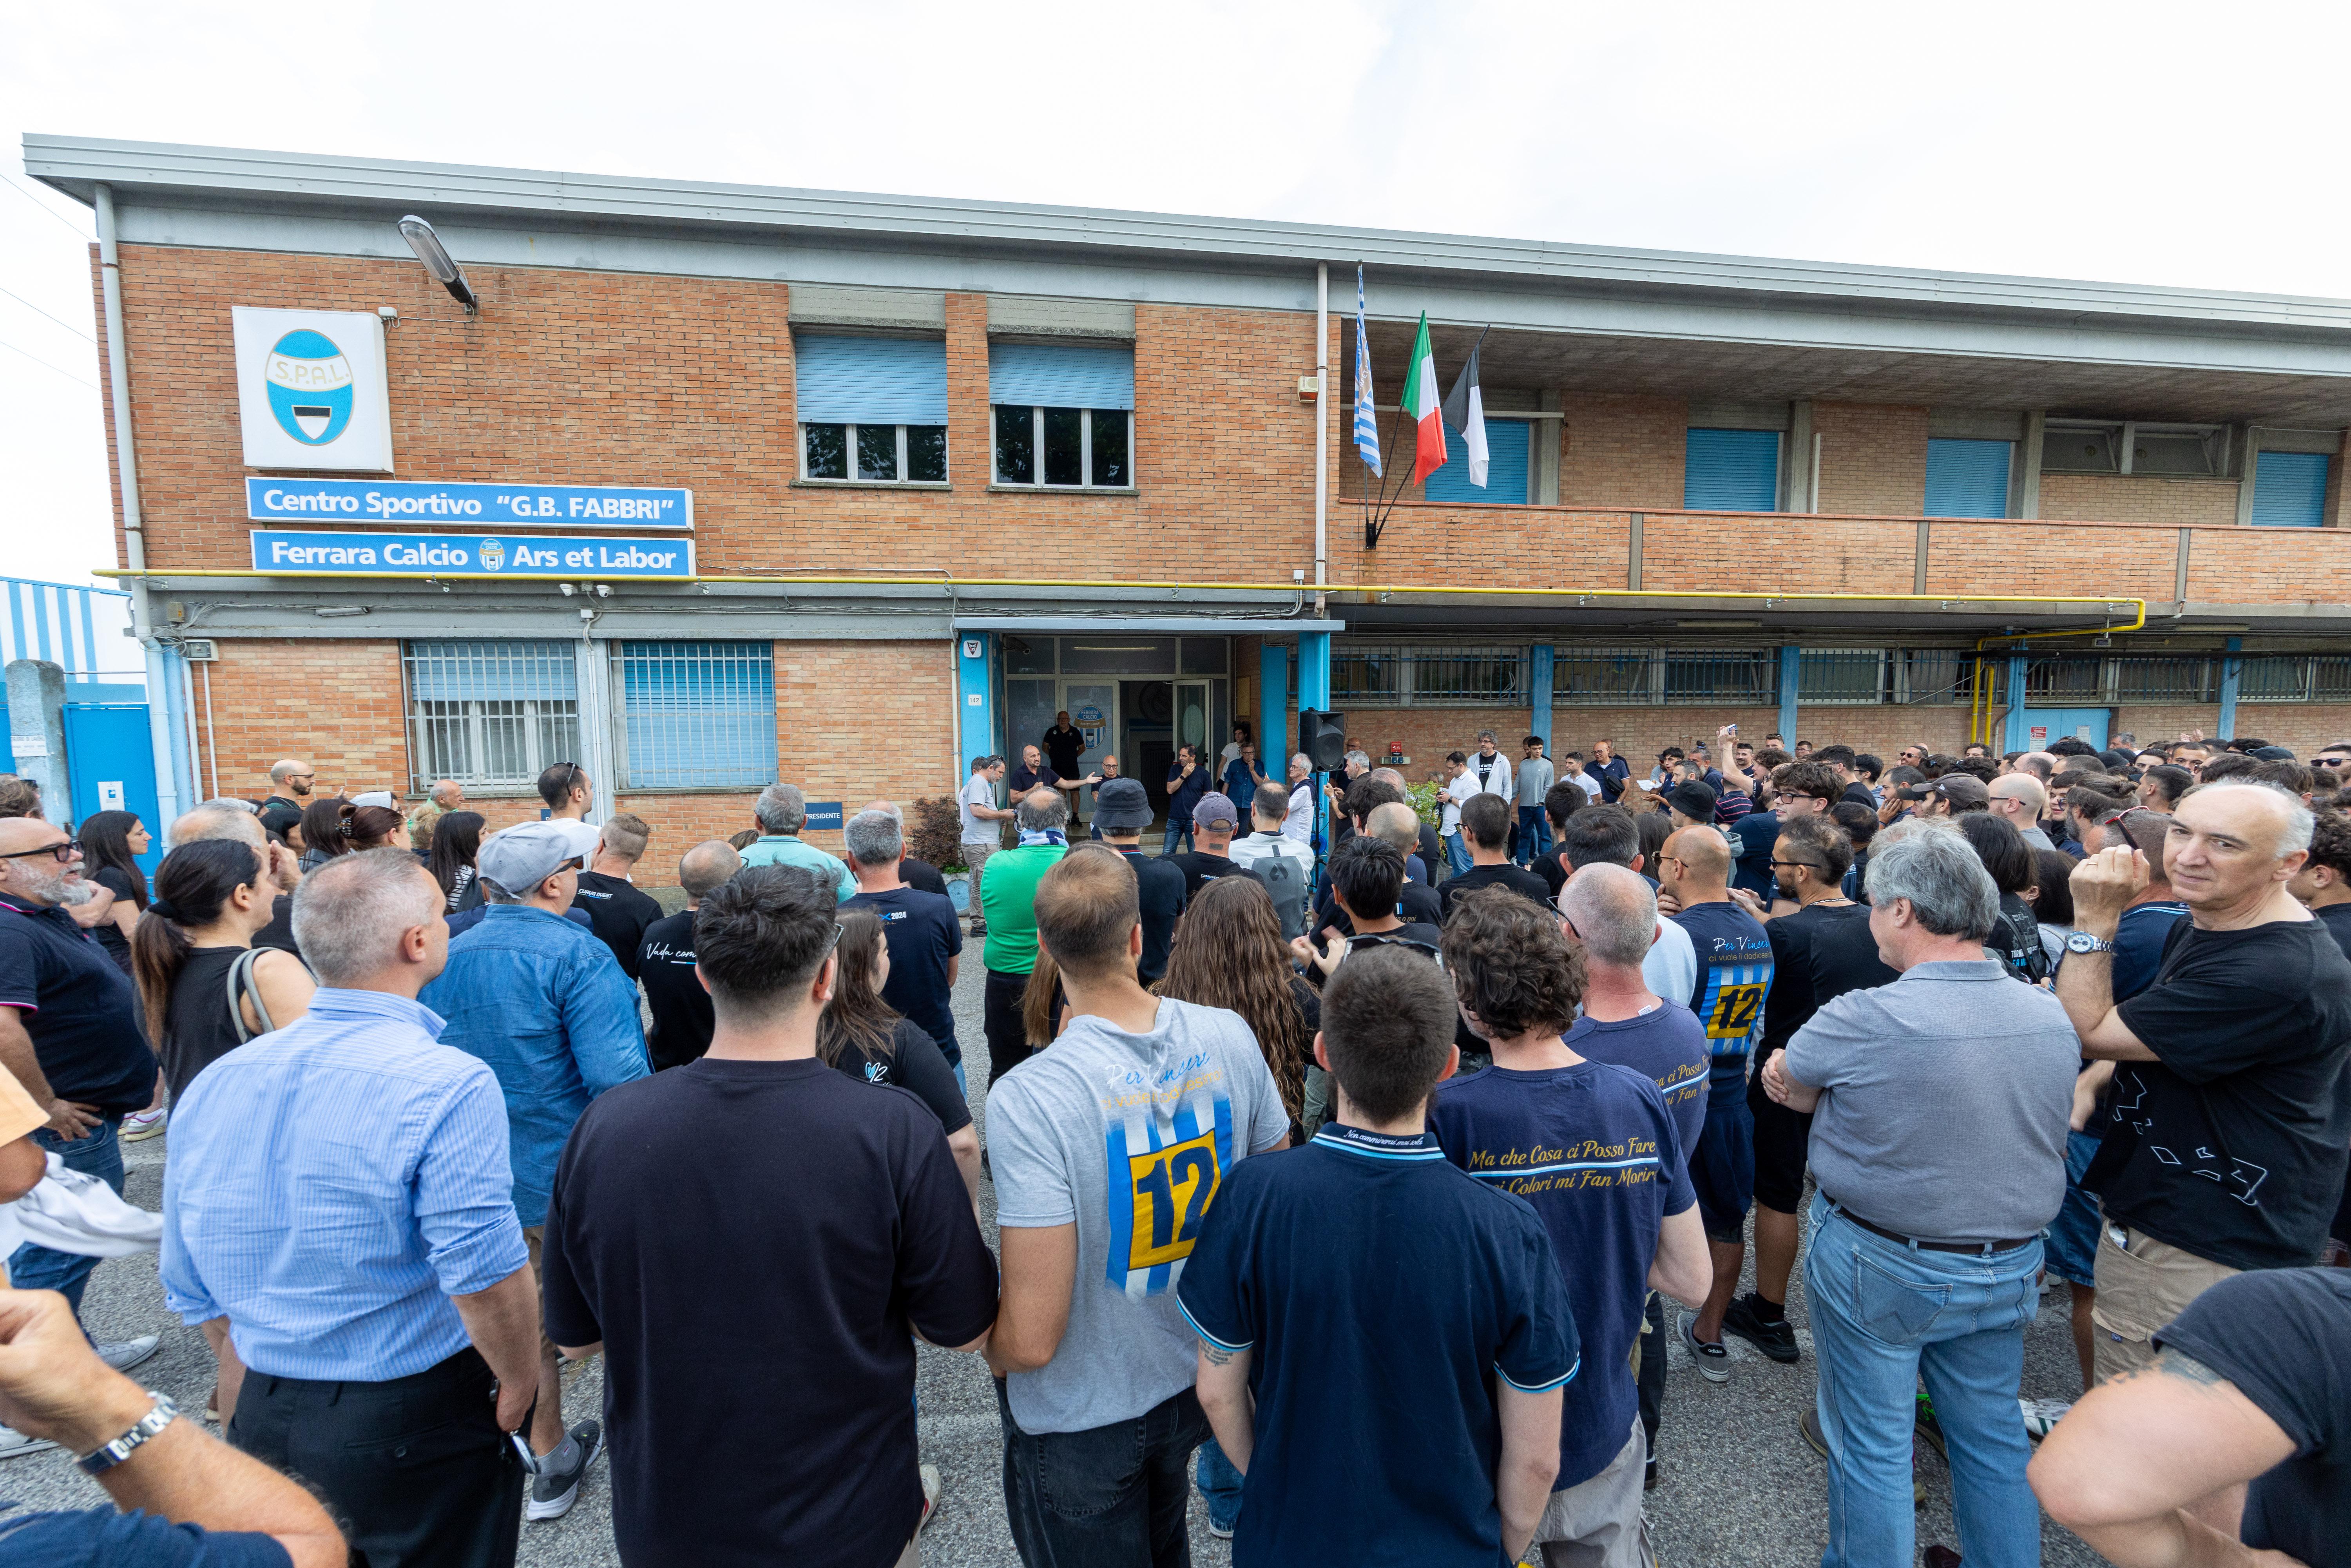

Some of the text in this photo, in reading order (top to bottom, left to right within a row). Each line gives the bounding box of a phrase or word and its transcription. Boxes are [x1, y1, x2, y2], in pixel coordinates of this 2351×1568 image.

[275, 361, 349, 384] S.P.A.L.
[264, 489, 359, 512] Centro
[365, 492, 482, 518] Sportivo
[272, 541, 469, 565] Ferrara Calcio
[513, 546, 676, 569] Ars et Labor
[891, 911, 907, 920] 2024
[647, 942, 674, 960] Vada
[1713, 936, 1771, 952] Per Vincer
[1709, 953, 1716, 962] ci
[1744, 951, 1773, 960] dodicesim
[1719, 987, 1762, 1029] 12
[1105, 1064, 1145, 1089] Per
[1668, 1070, 1676, 1083] ci
[1677, 1064, 1701, 1079] Posso
[1100, 1095, 1112, 1110] ci
[1115, 1090, 1150, 1108] vuole
[1677, 1087, 1697, 1104] Fan
[1343, 1129, 1359, 1139] Non
[1468, 1137, 1656, 1169] Ma che Cosa ci Posso Fare
[1509, 1175, 1553, 1195] Colori
[1555, 1173, 1576, 1188] mi
[1579, 1170, 1612, 1190] Fan
[1137, 1146, 1215, 1249] 12
